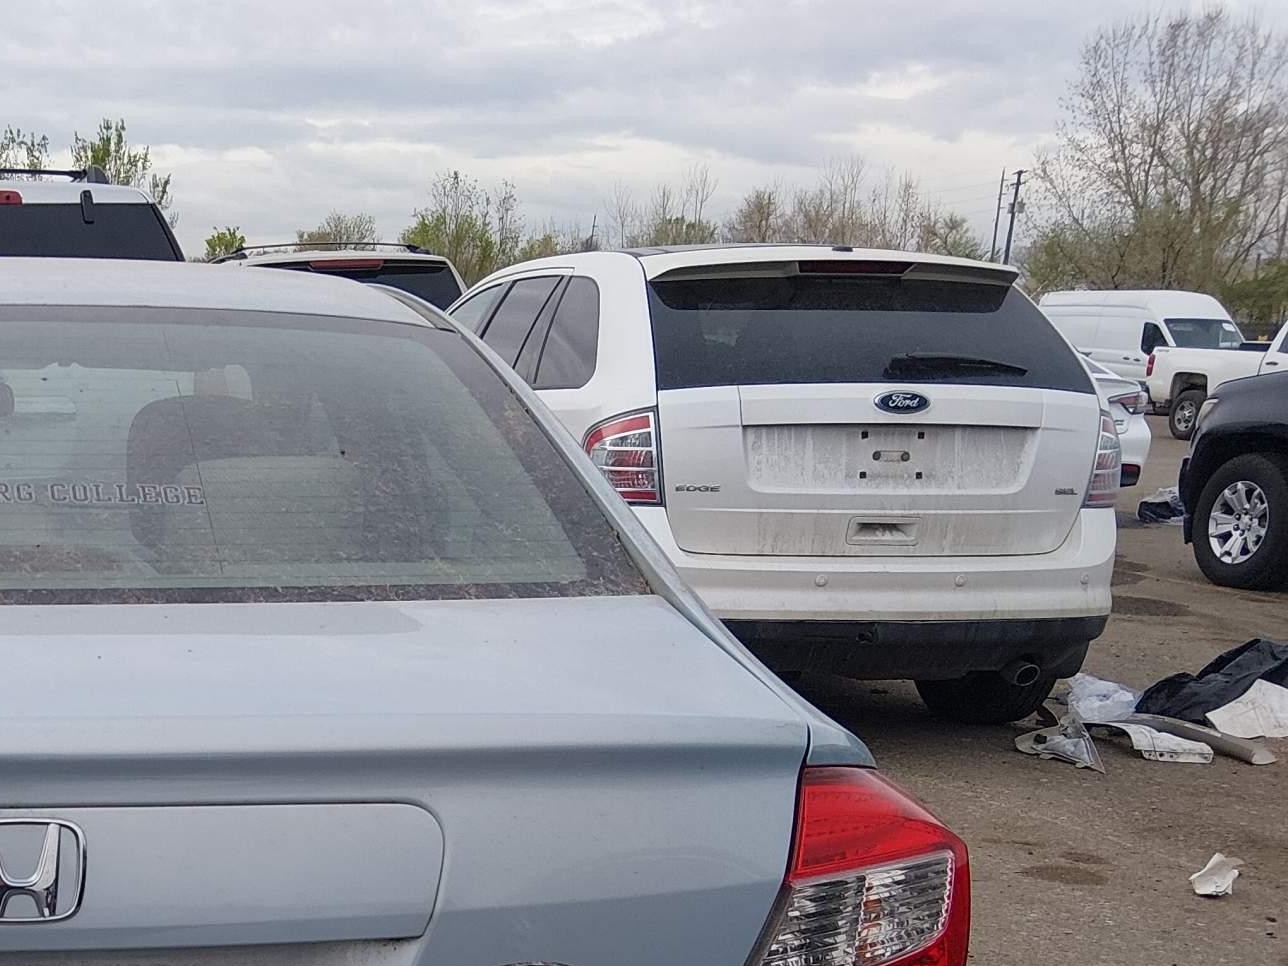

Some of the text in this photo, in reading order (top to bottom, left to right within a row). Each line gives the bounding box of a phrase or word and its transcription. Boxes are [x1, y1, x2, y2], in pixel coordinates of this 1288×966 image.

[888, 393, 920, 407] Ford
[48, 482, 206, 506] COLLEGE
[675, 484, 720, 493] EDGE
